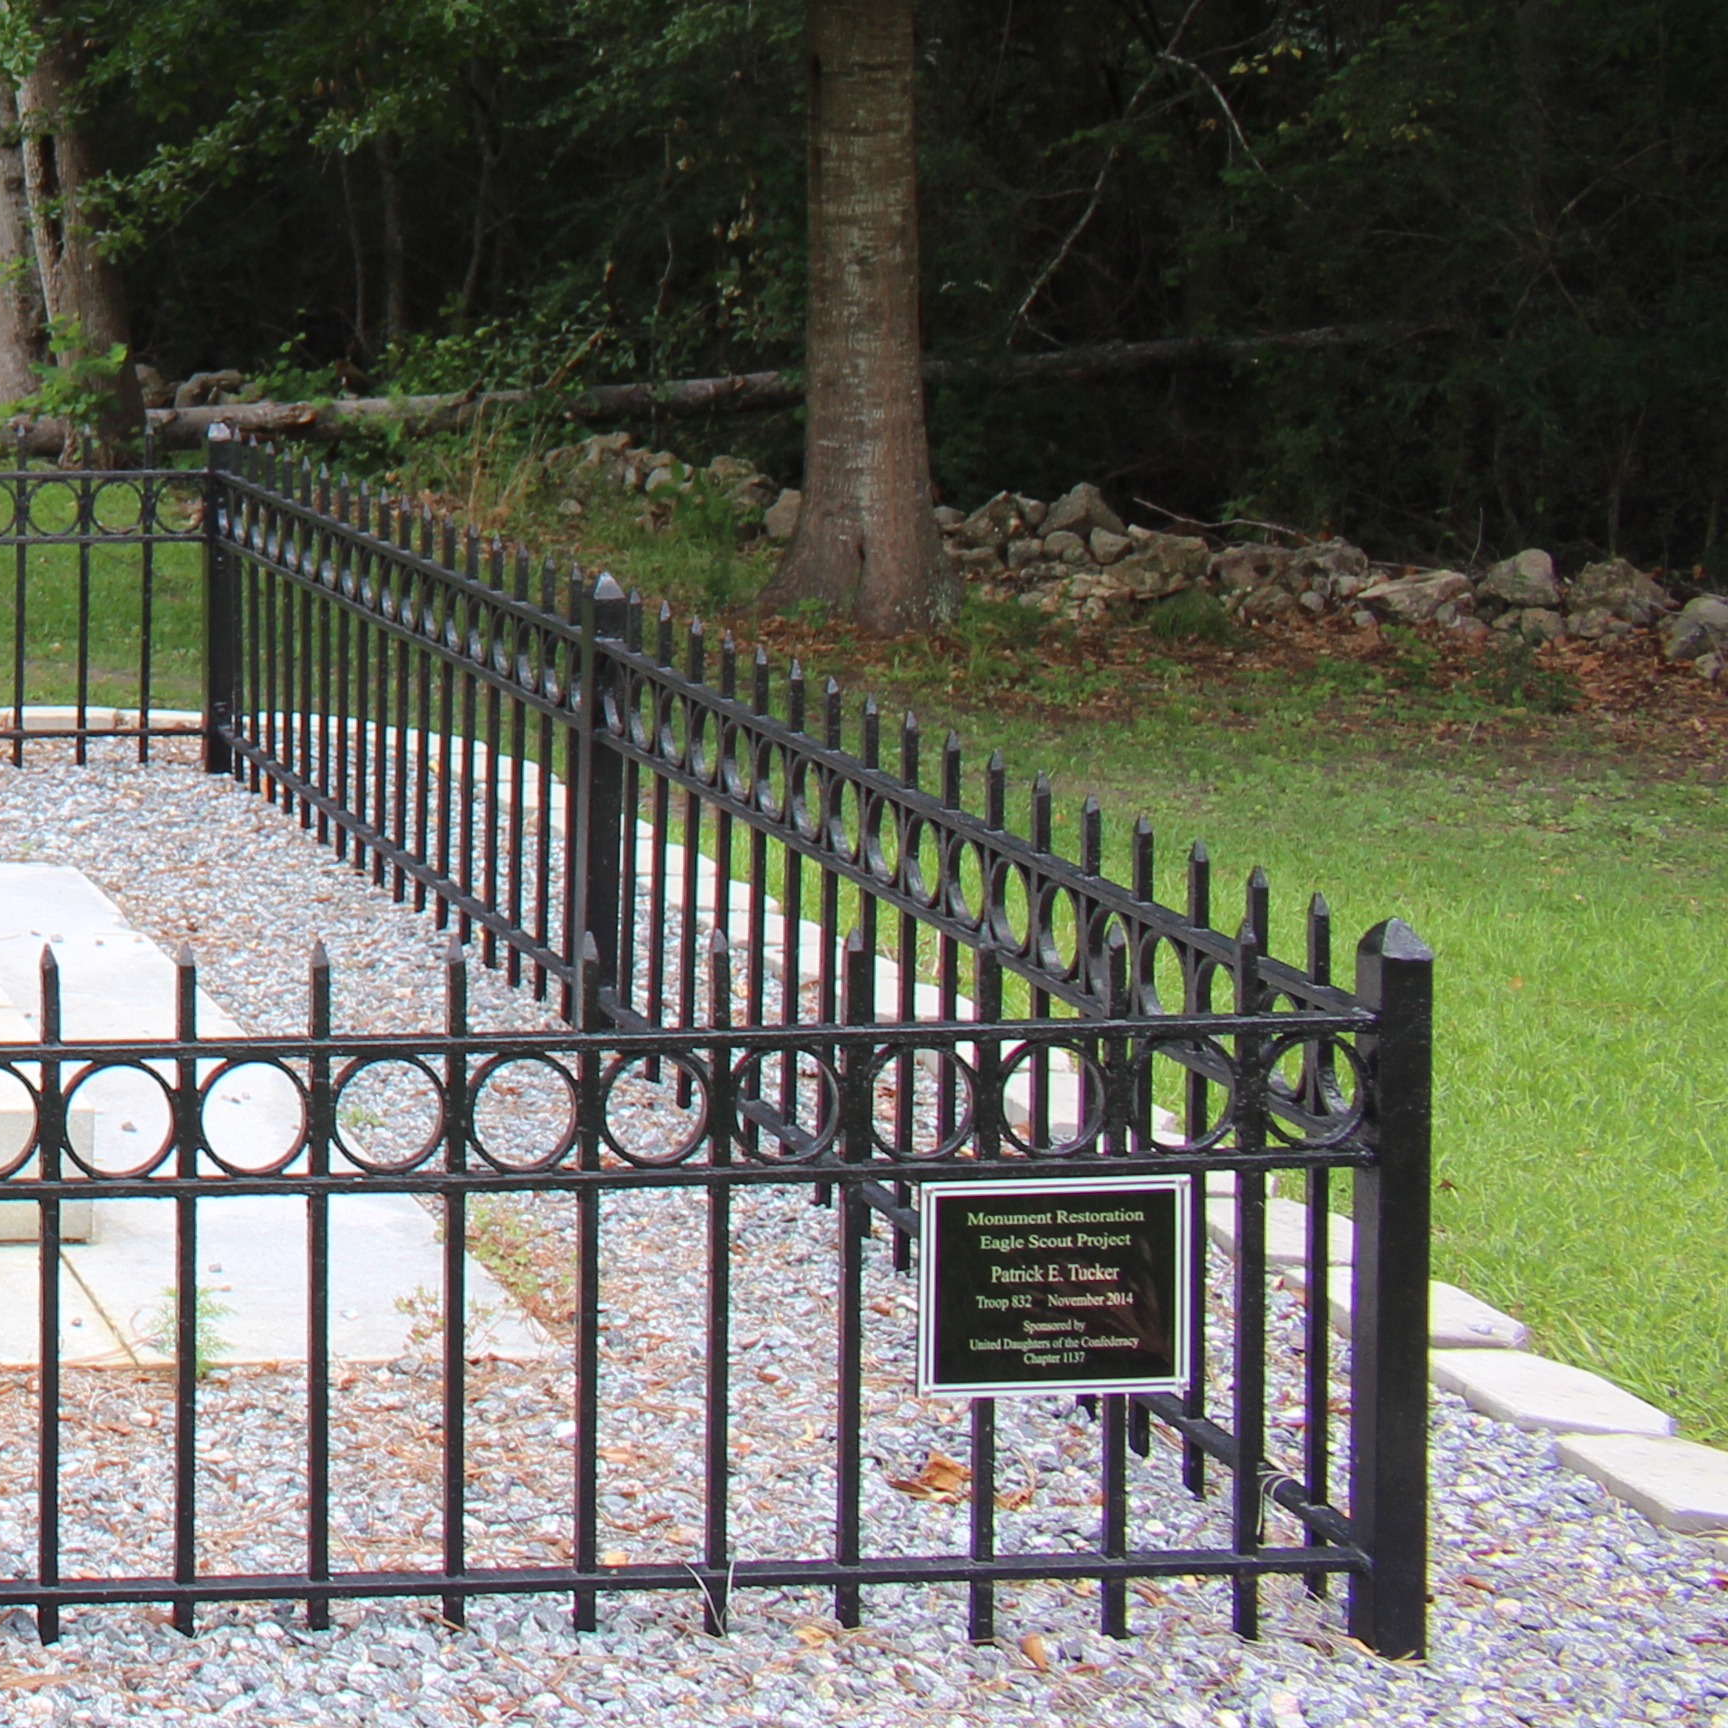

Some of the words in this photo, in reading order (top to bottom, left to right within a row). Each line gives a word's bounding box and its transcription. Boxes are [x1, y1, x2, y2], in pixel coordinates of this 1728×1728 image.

[967, 1212, 1053, 1226] Monument
[1056, 1208, 1145, 1224] Restoration
[979, 1235, 1025, 1252] Eagle
[1028, 1234, 1073, 1249] Scout
[1076, 1232, 1132, 1250] Project
[991, 1265, 1044, 1283] Patrick
[1048, 1264, 1064, 1282] E.
[1068, 1263, 1120, 1281] Tucker
[976, 1296, 1010, 1311] Troop
[1011, 1295, 1032, 1308] 832
[1047, 1293, 1105, 1307] November
[1106, 1292, 1134, 1306] 2014
[1023, 1320, 1072, 1334] Sponsored
[1073, 1319, 1086, 1333] by
[969, 1339, 1001, 1350] United
[1003, 1338, 1050, 1352] Daughters
[1052, 1338, 1064, 1349] of
[1064, 1337, 1079, 1349] the
[1081, 1336, 1139, 1349] Confederacy
[1023, 1352, 1061, 1366] Chapter
[1063, 1351, 1085, 1363] 1137
